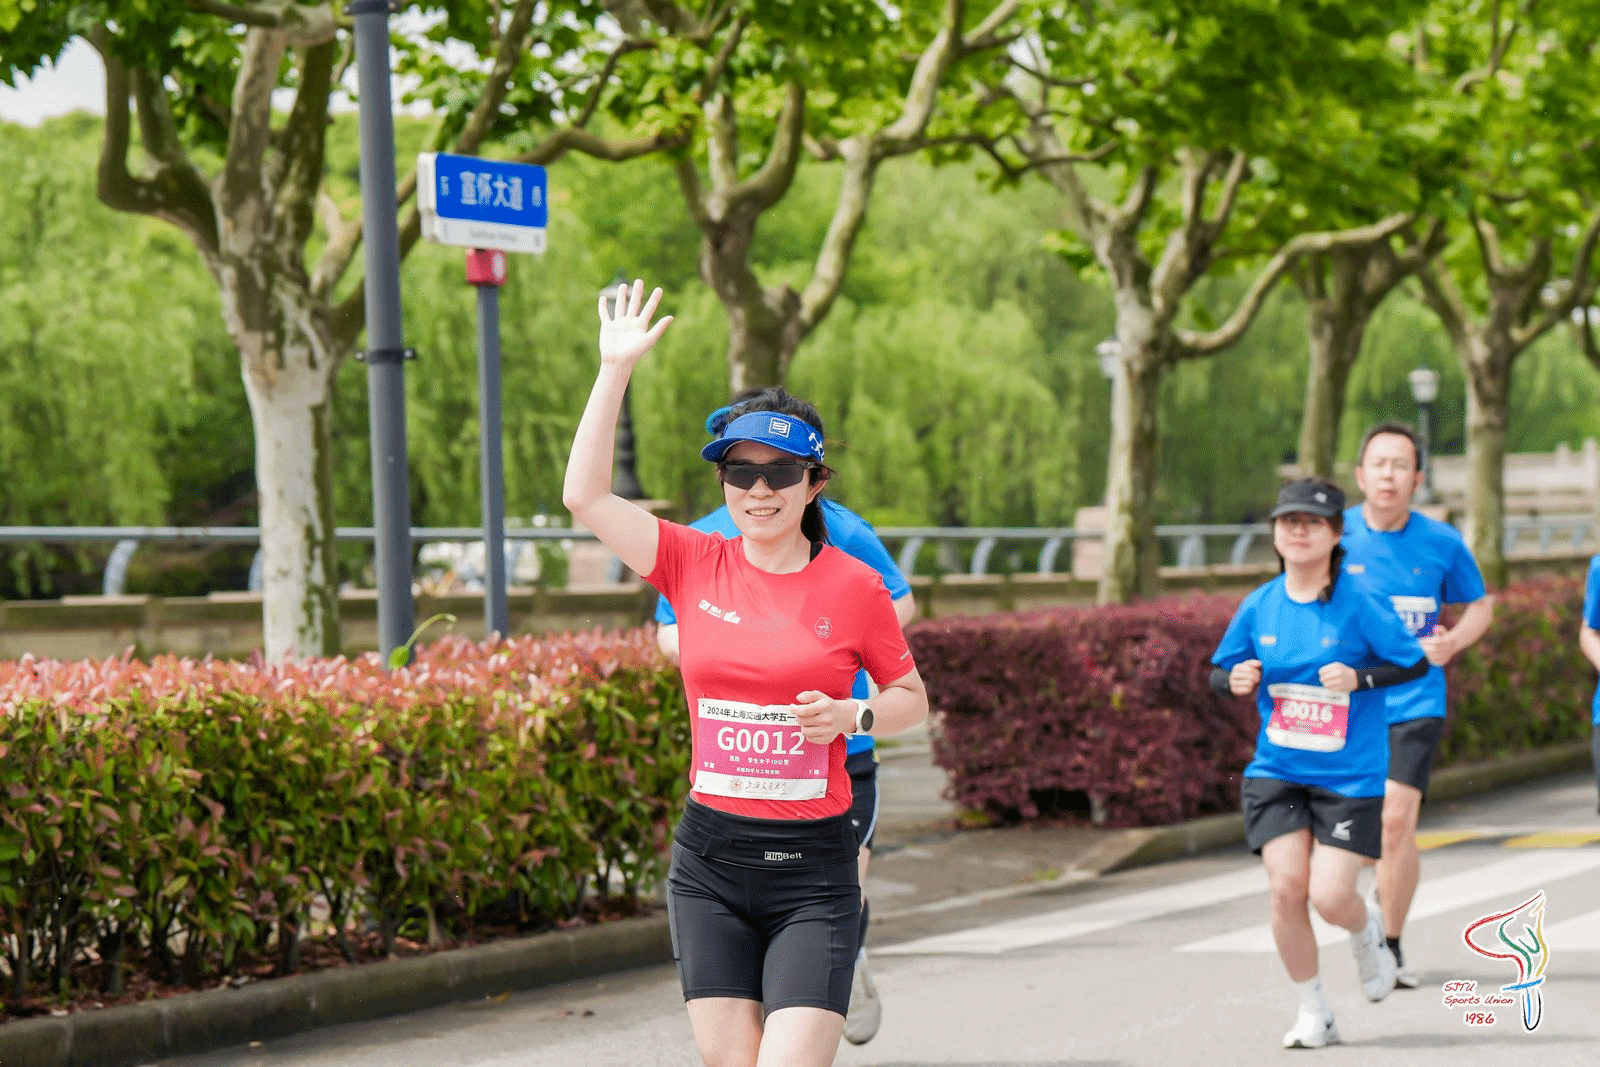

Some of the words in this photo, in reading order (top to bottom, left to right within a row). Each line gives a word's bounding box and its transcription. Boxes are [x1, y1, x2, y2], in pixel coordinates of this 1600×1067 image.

[706, 706, 797, 722] 2024年上海交通大学五一
[717, 726, 805, 755] G0012
[764, 851, 802, 861] FlipBelt
